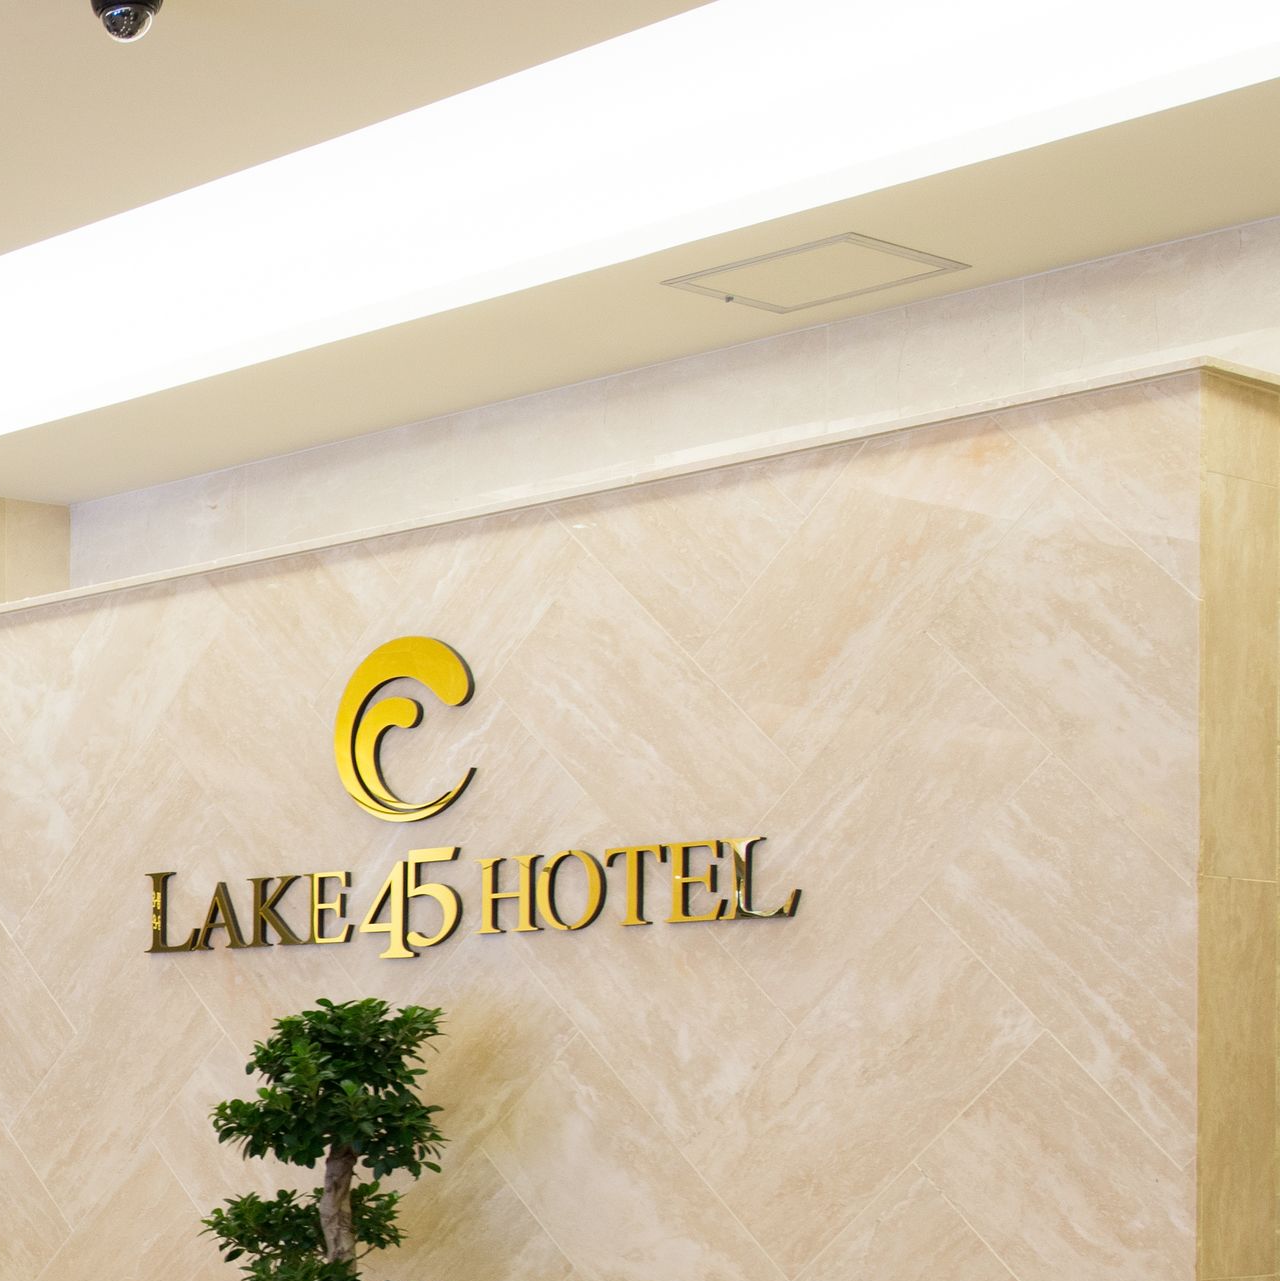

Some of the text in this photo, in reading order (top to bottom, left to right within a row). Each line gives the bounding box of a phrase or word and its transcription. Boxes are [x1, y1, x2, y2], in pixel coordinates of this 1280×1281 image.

[144, 836, 803, 959] LAKE 45 HOTEL
